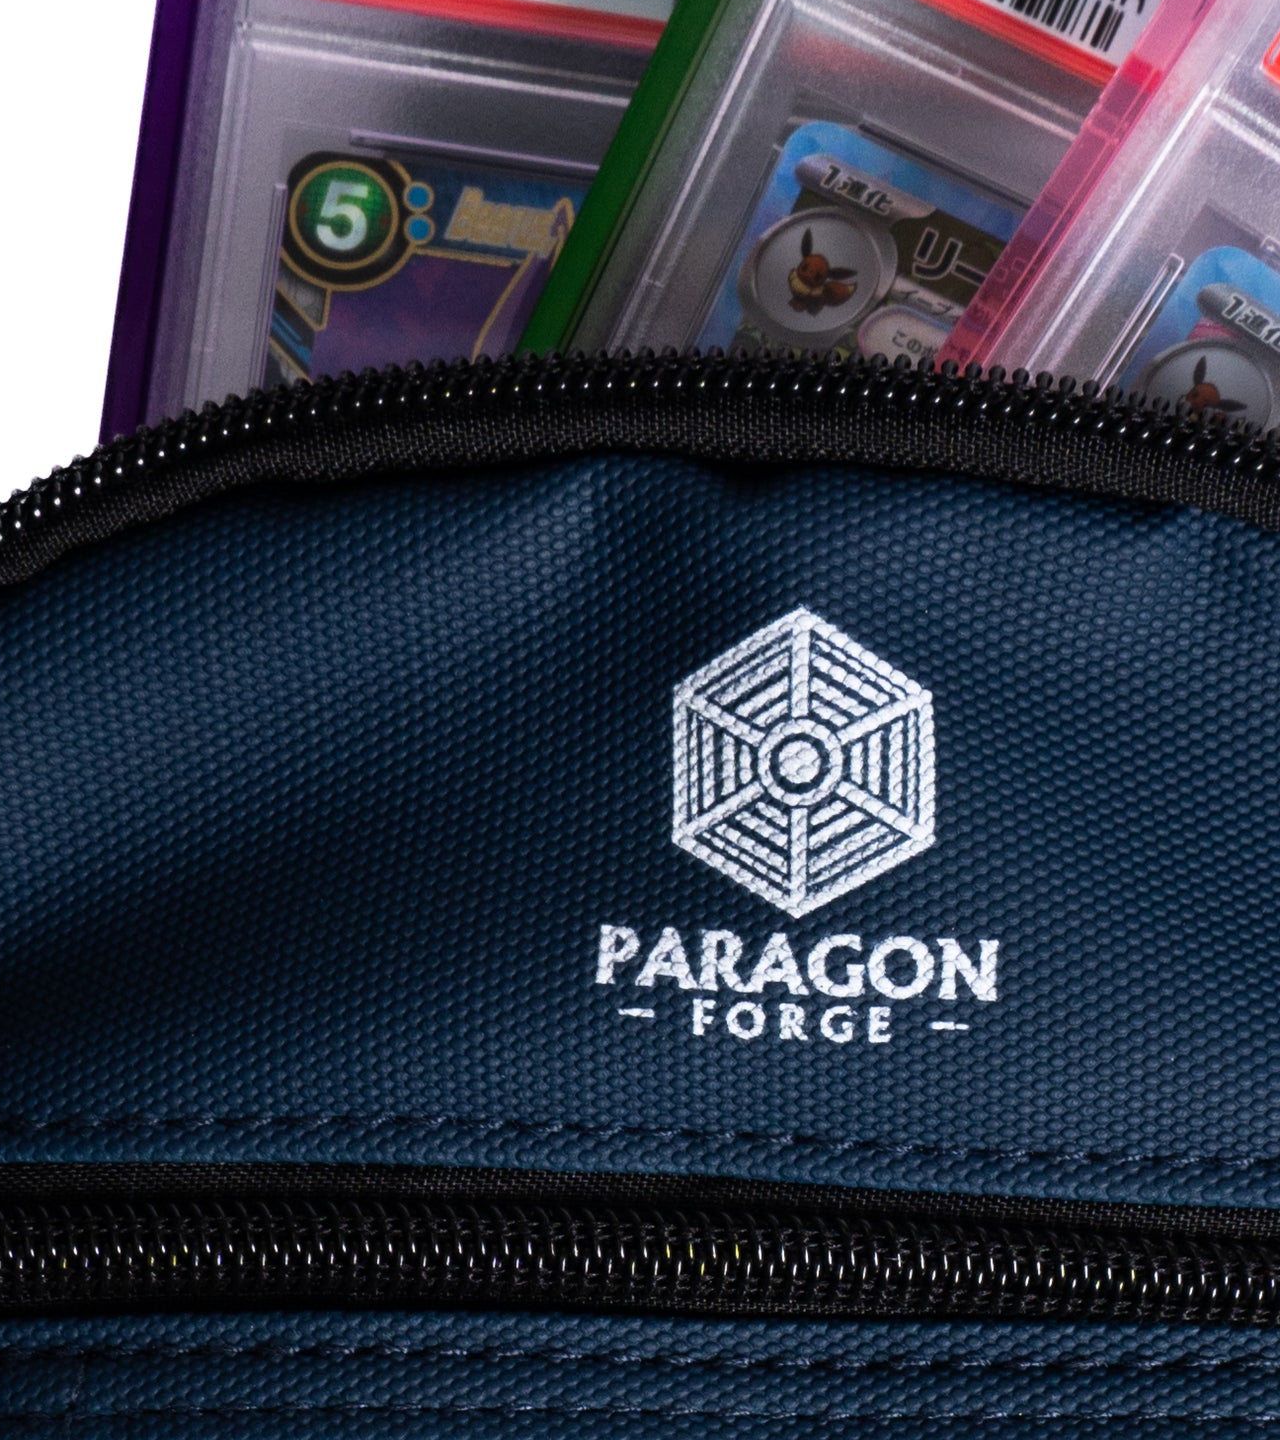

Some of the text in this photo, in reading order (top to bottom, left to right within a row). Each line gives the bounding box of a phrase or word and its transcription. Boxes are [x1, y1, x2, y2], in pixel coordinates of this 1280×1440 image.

[316, 180, 368, 252] 5
[594, 924, 1000, 1002] PARAGON
[691, 998, 893, 1044] FORGE
